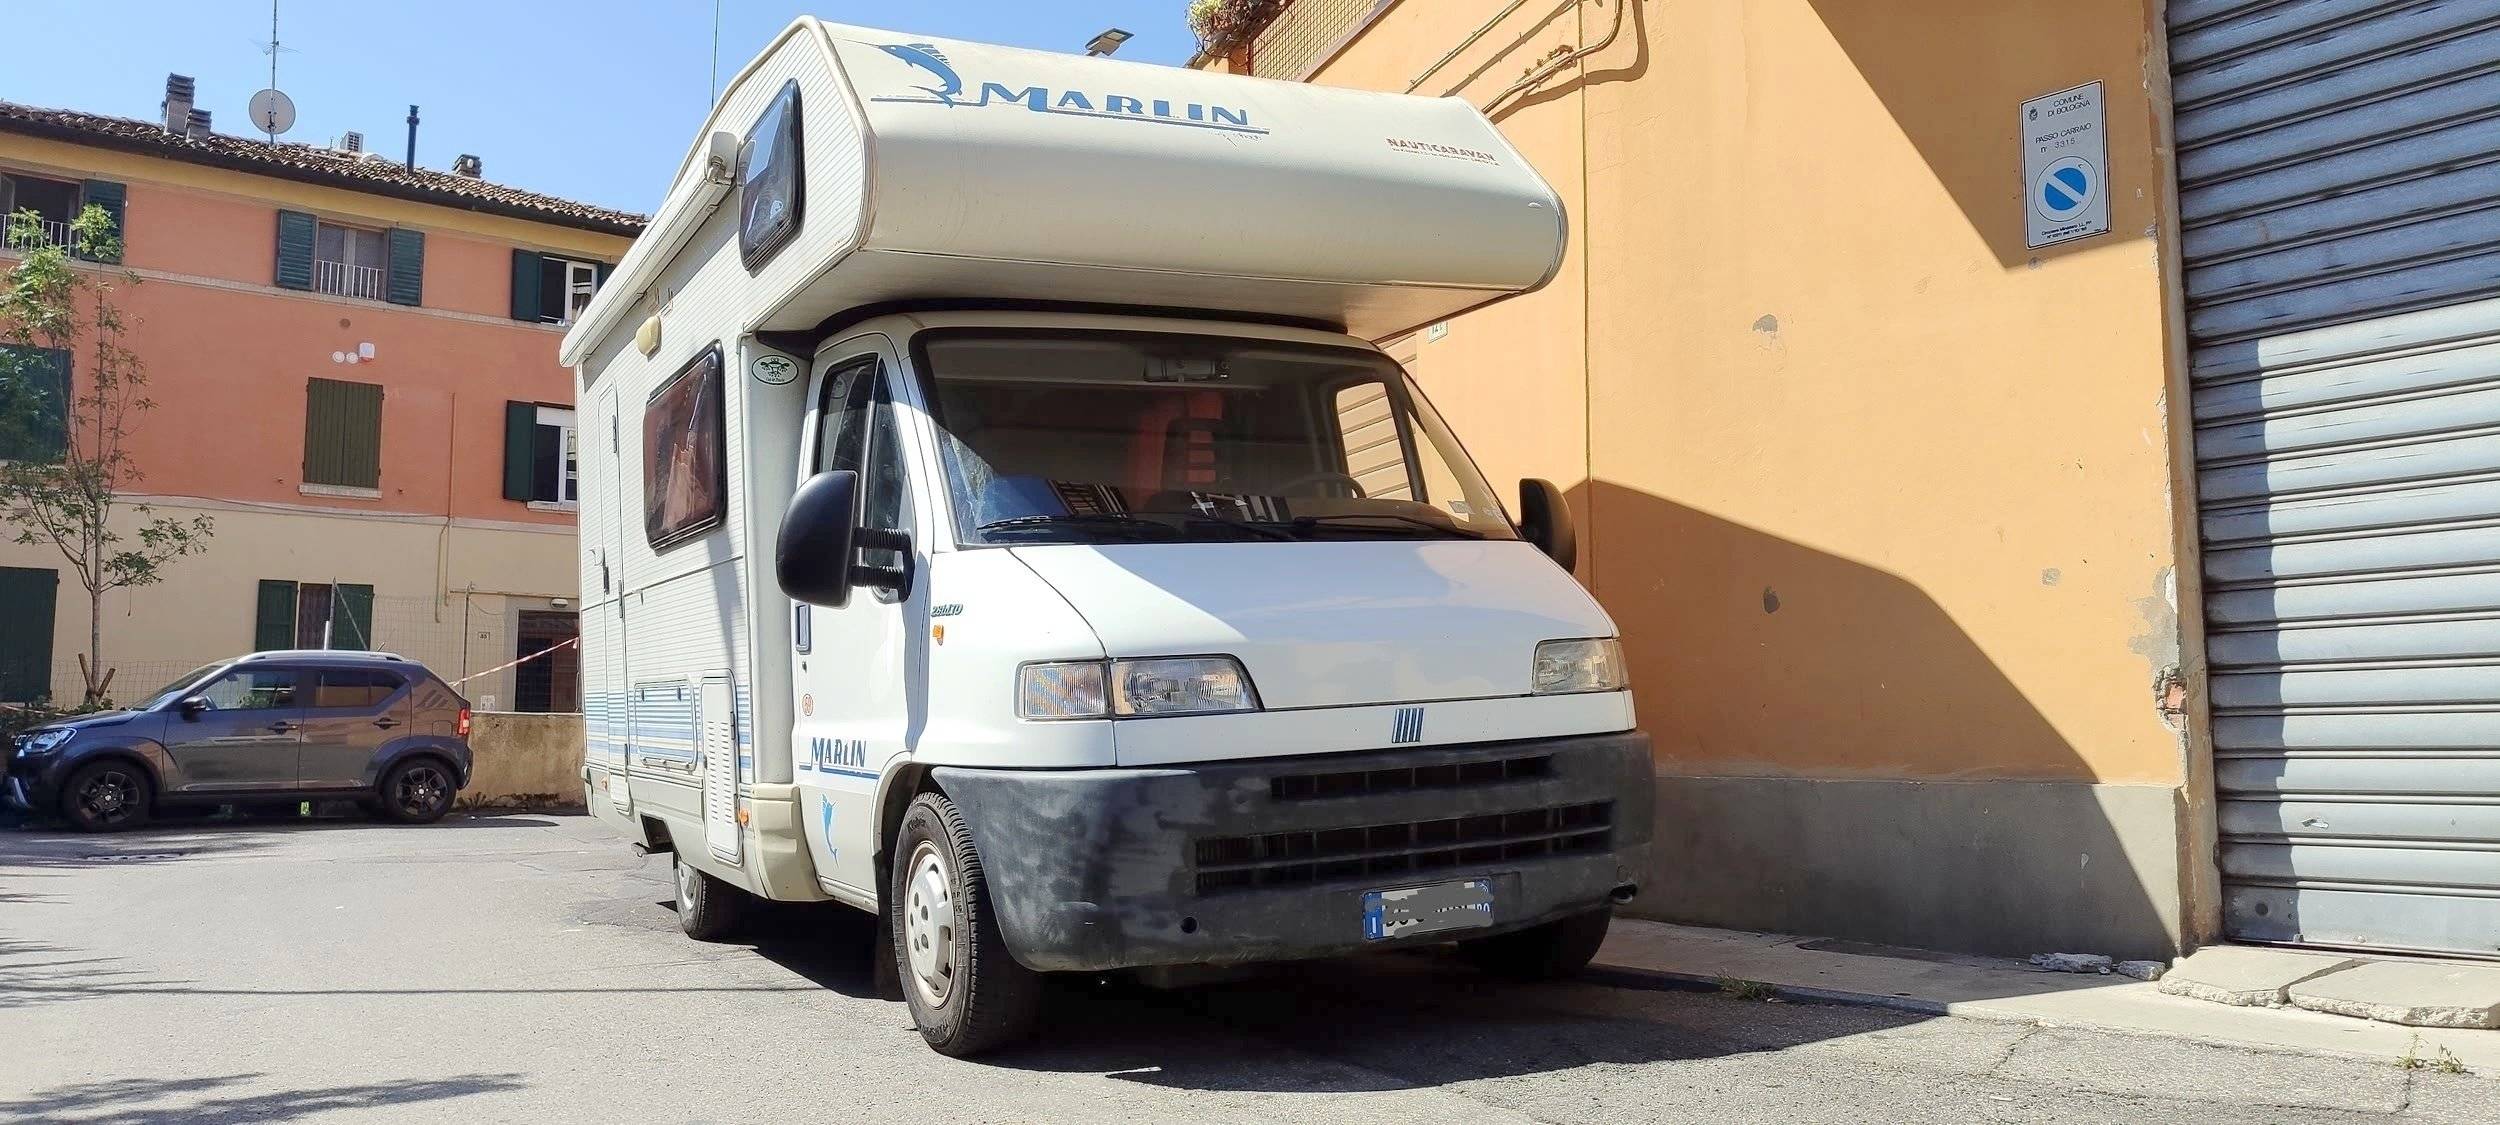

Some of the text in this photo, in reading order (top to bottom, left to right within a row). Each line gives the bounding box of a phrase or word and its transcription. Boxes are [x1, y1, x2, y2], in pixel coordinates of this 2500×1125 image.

[978, 82, 1247, 125] MARLIN
[2053, 94, 2084, 107] COMUNE
[2056, 100, 2091, 115] BOLOGNA
[2035, 122, 2092, 144] PASSO CARRAIO
[1386, 138, 1495, 161] NAUTICARAVAN
[811, 737, 866, 771] MARLIN
